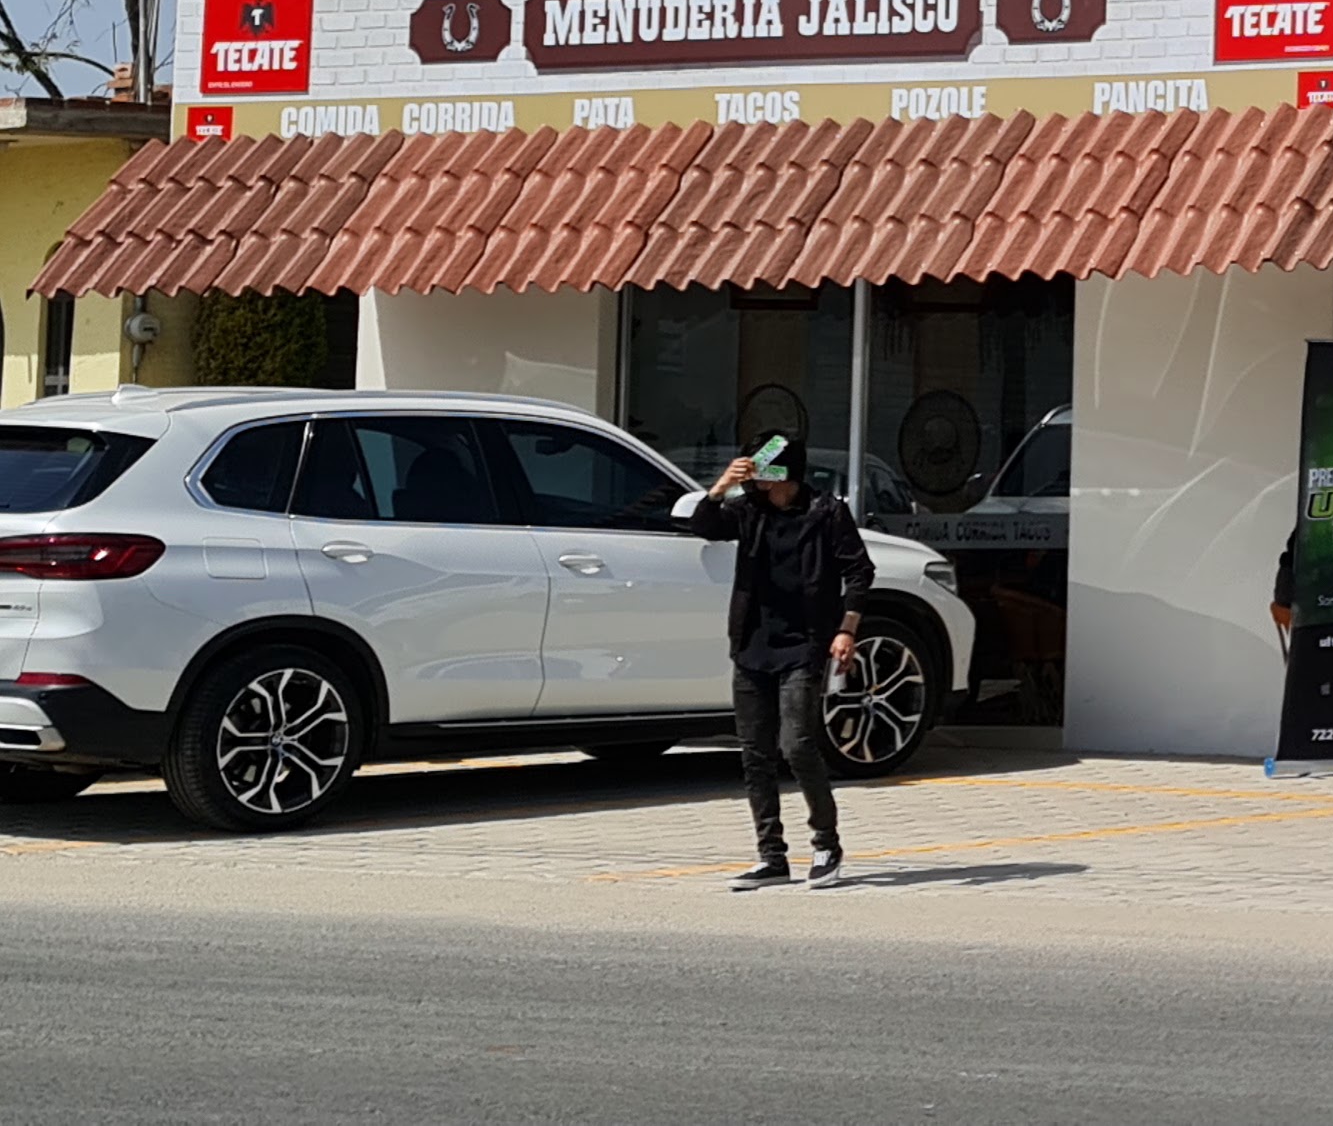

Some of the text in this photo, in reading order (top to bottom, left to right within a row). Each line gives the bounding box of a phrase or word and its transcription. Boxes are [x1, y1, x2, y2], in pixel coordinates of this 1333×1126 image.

[1224, 1, 1331, 38] TECATE
[209, 40, 305, 72] TECATE
[572, 97, 635, 130] PATA
[714, 90, 800, 125] TACOS
[892, 86, 987, 121] POZOLE
[1093, 79, 1208, 116] PANCITA
[280, 101, 516, 139] COMIDA CORRIDA
[1311, 729, 1333, 741] 722
